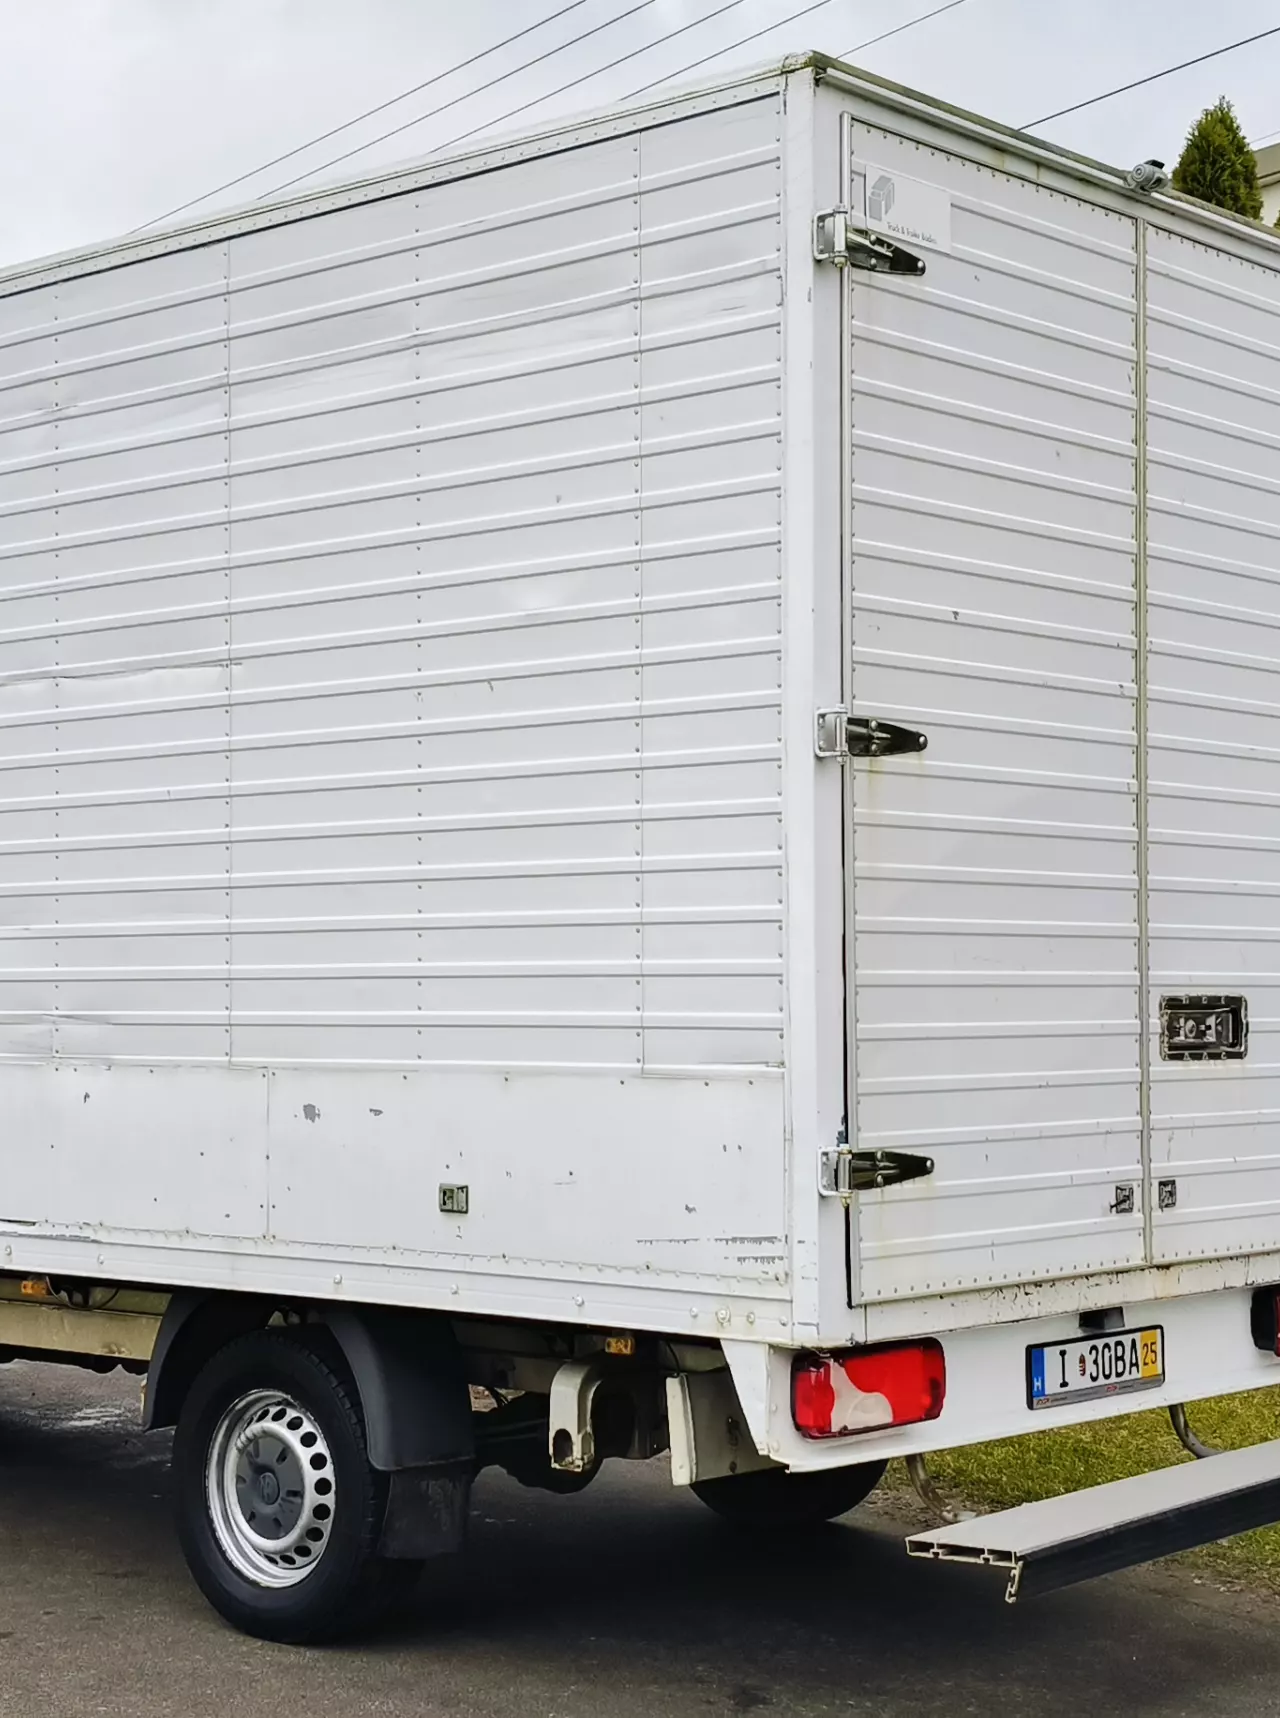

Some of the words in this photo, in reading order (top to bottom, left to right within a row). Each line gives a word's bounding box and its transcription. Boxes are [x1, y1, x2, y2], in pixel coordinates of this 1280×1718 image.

[1088, 1337, 1140, 1383] 30BA
[1142, 1341, 1157, 1367] 25
[1033, 1377, 1042, 1393] H
